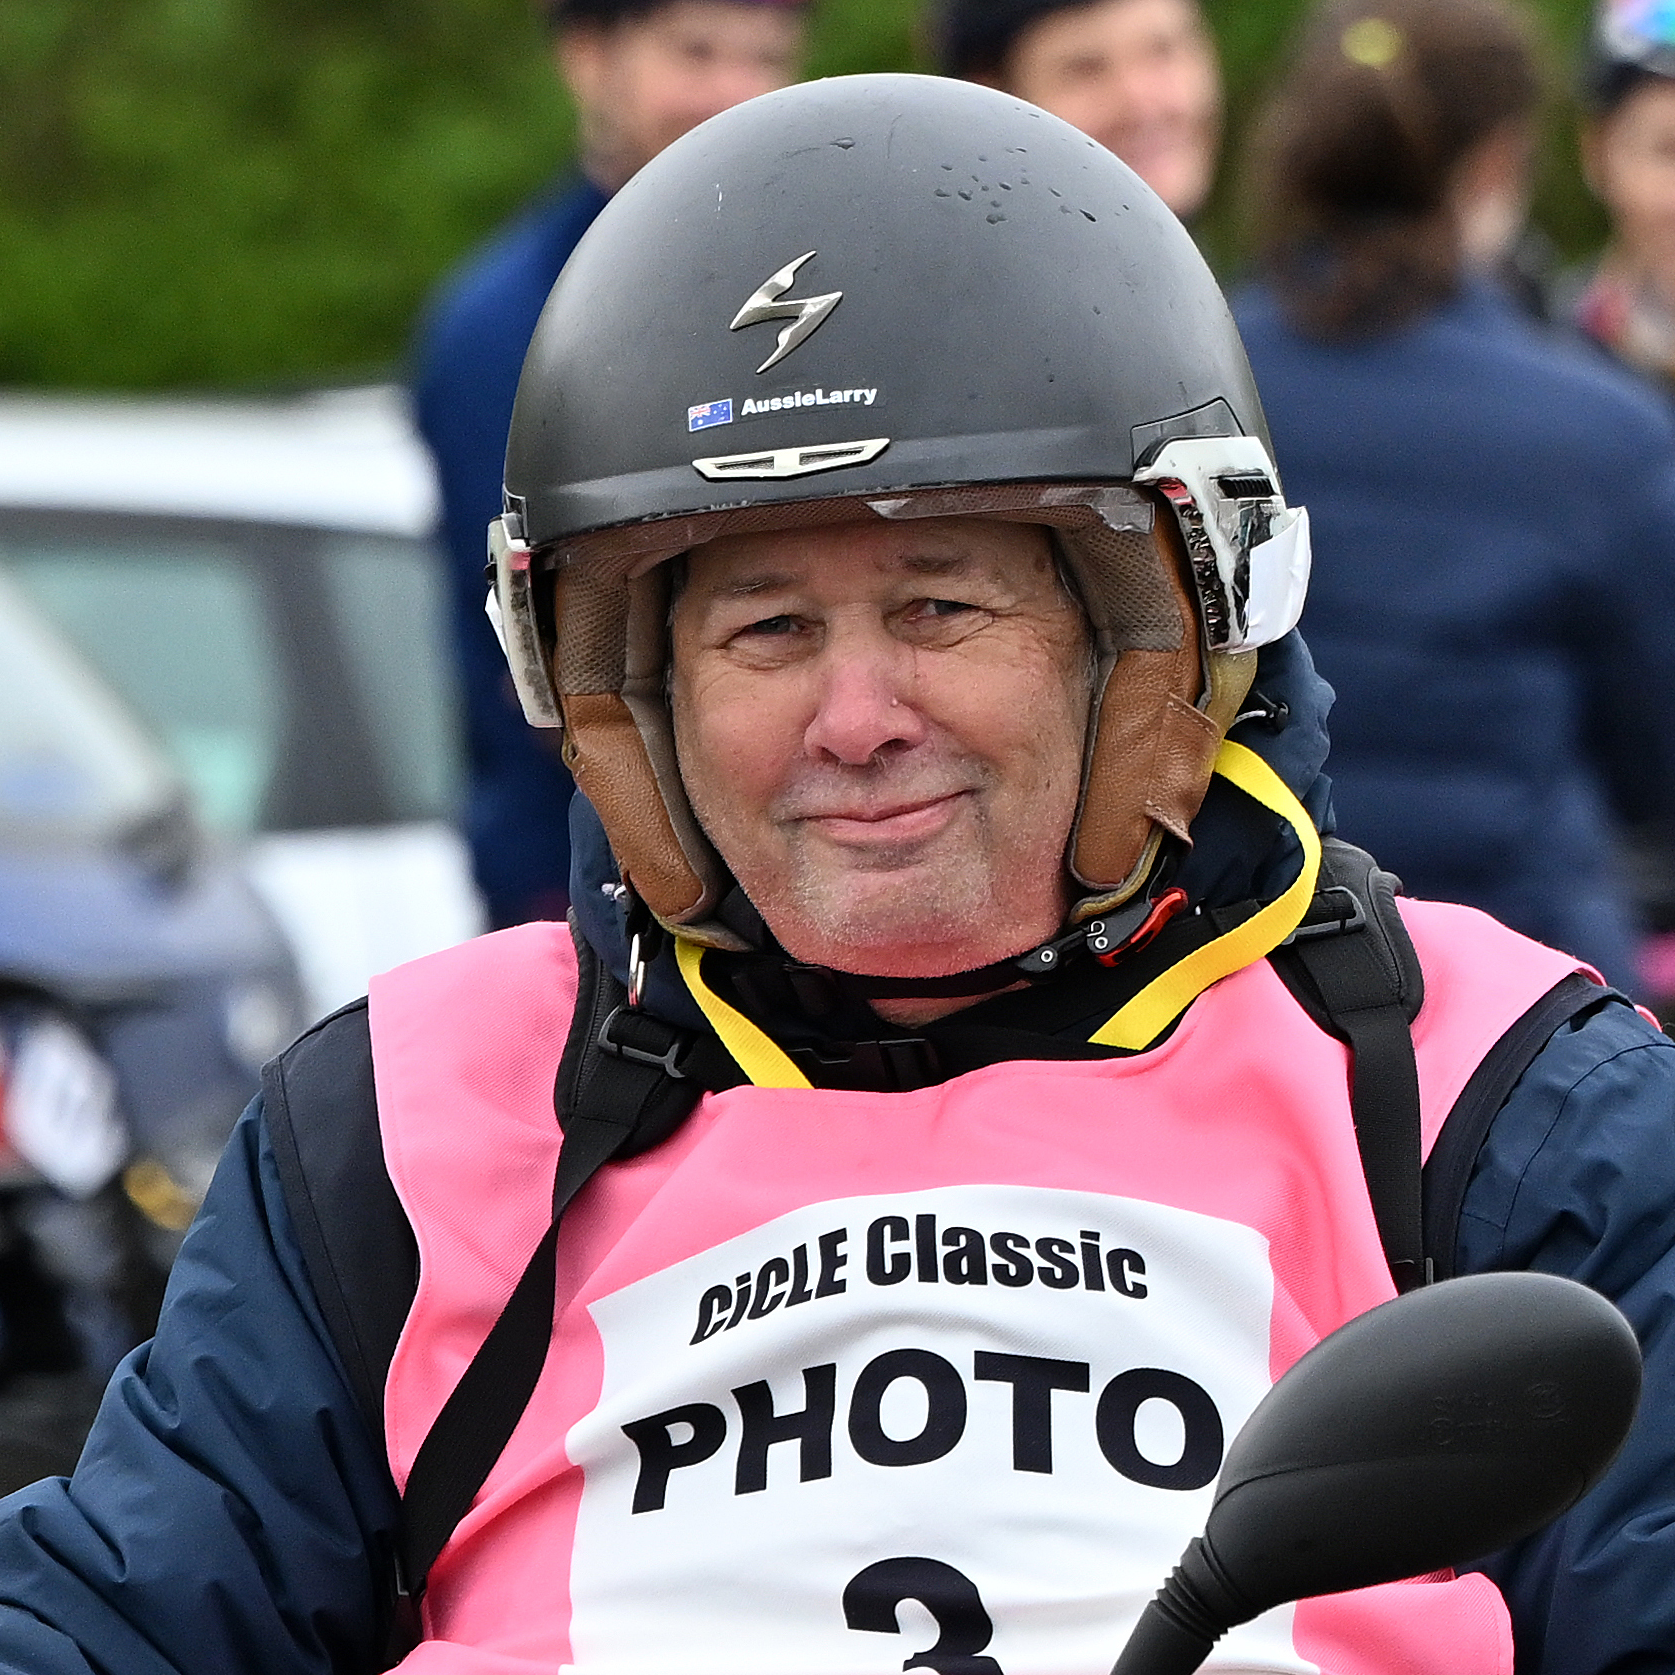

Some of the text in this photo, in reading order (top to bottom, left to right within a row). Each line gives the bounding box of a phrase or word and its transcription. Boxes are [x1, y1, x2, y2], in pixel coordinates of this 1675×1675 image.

[740, 388, 878, 416] AussieLarry
[688, 1212, 1149, 1346] CiCLE Classic
[620, 1346, 1225, 1516] PHOTO
